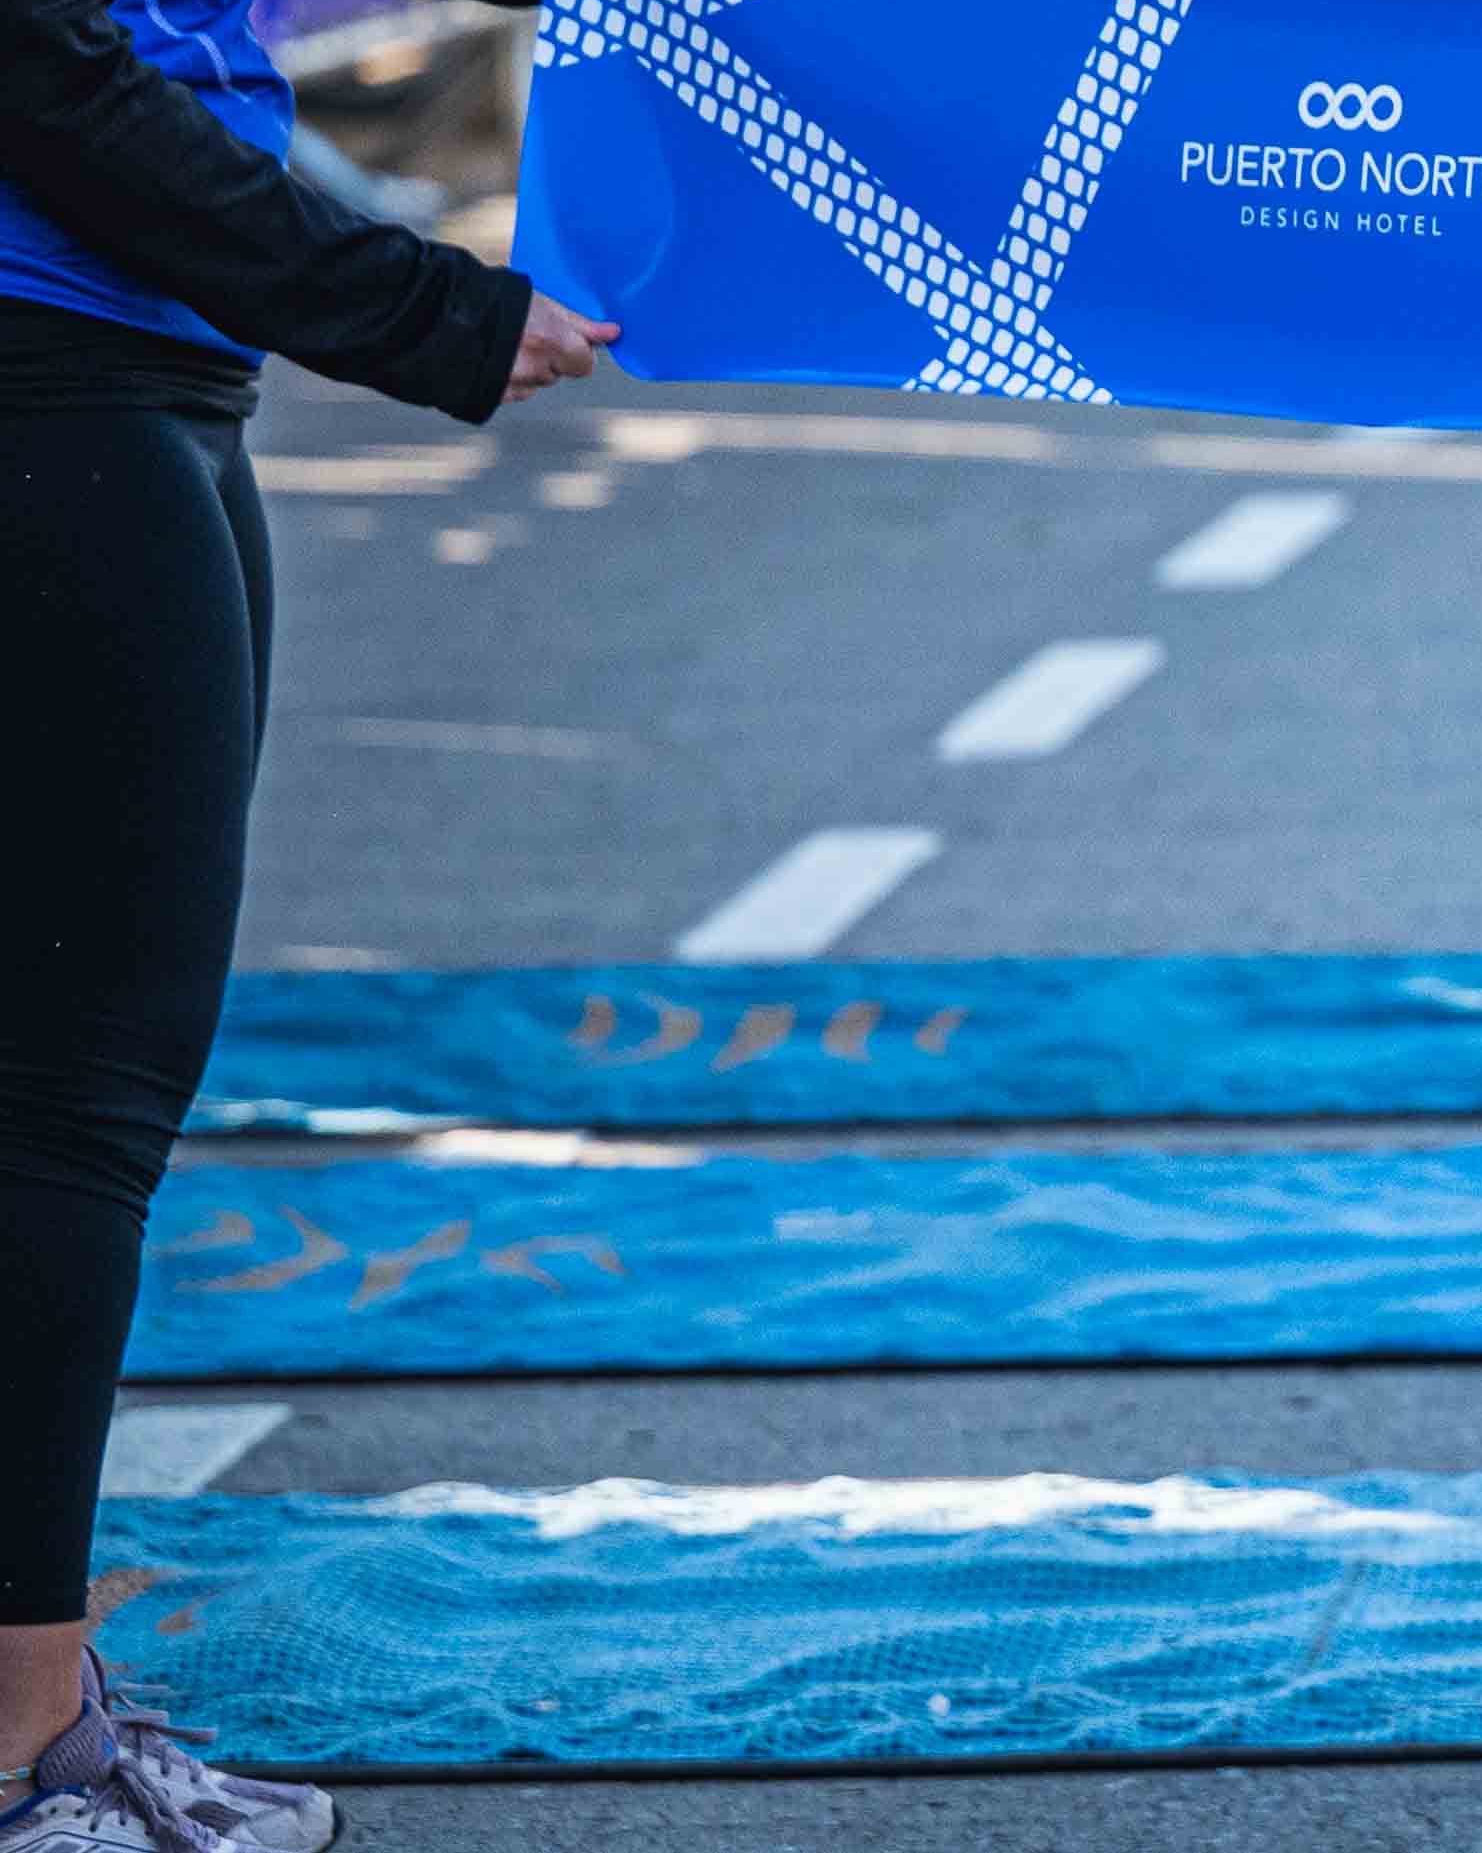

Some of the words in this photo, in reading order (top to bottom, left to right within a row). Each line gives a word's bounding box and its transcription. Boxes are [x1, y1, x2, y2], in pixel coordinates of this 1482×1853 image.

[1181, 141, 1347, 192] PUERTO
[1240, 205, 1340, 231] DESIGN
[1357, 213, 1443, 237] HOTEL
